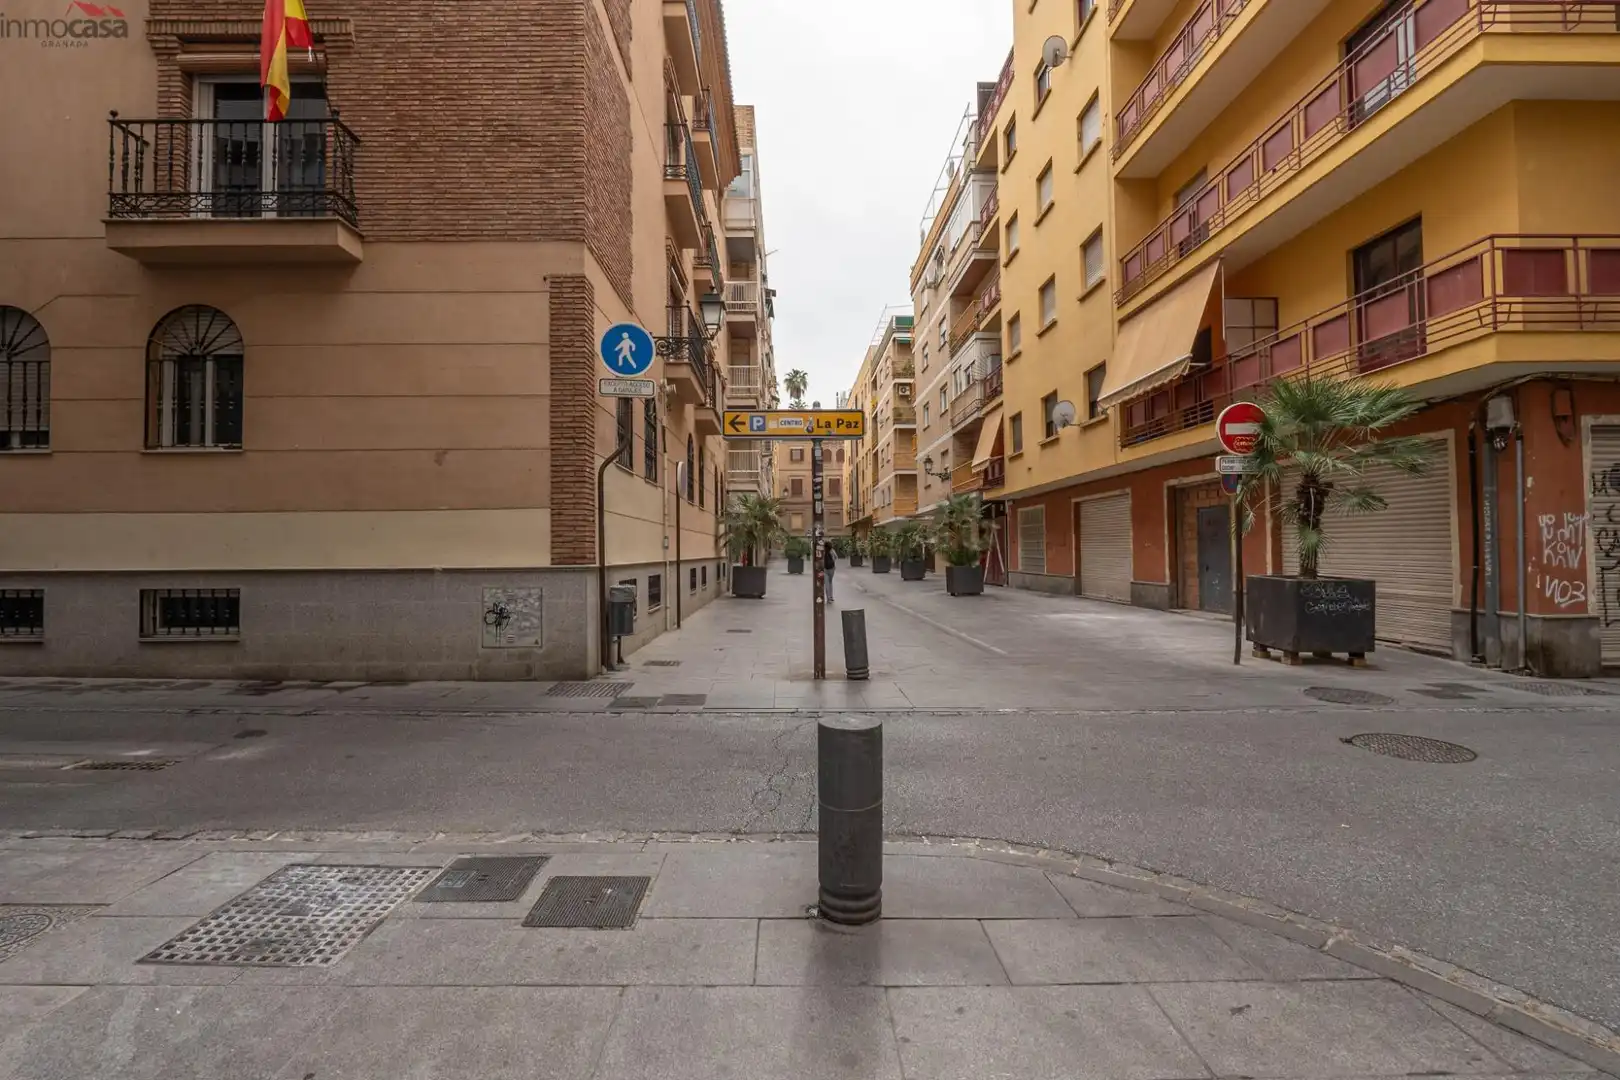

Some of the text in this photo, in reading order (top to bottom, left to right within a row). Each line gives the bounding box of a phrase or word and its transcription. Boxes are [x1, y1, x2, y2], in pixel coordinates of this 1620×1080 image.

[752, 416, 764, 431] P
[816, 418, 832, 429] La
[836, 418, 860, 429] Paz
